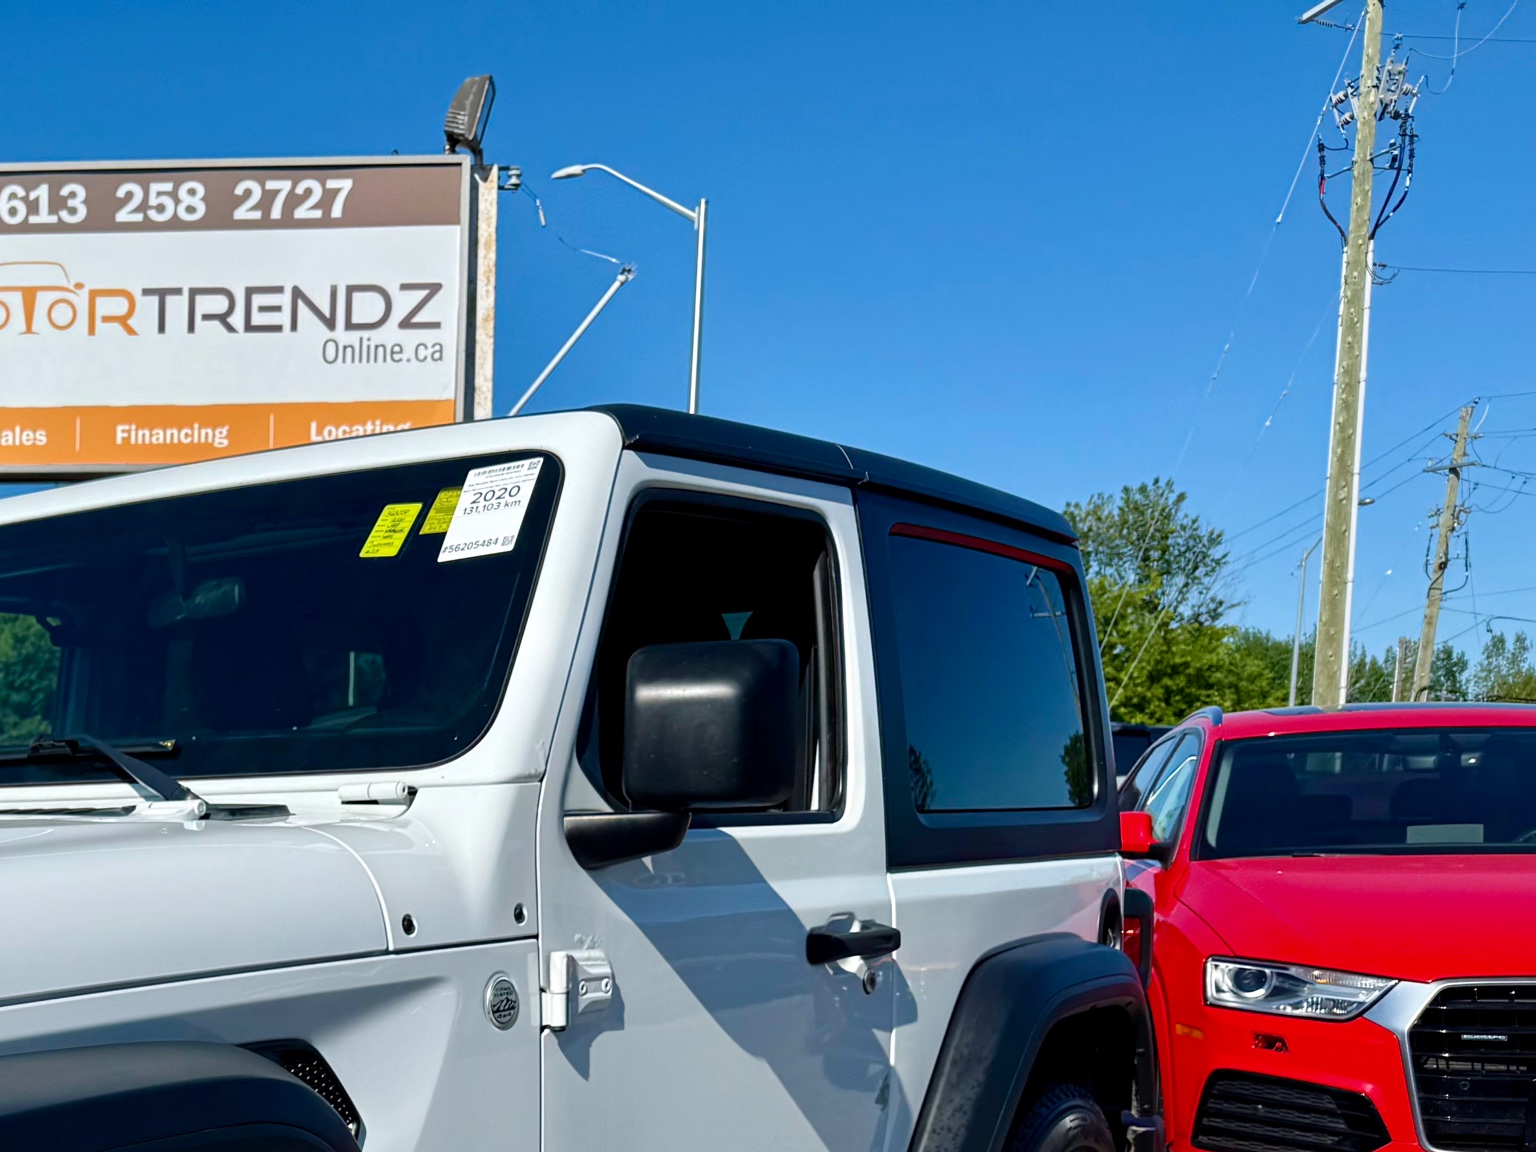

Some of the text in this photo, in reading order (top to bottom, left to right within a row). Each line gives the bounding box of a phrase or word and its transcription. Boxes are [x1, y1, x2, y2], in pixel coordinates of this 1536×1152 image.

[114, 181, 206, 222] 258
[232, 178, 354, 220] 2727
[322, 336, 444, 364] Online.ca
[115, 423, 230, 449] Financing
[470, 485, 521, 505] 2020
[463, 499, 522, 516] 131,103 km
[442, 537, 499, 554] #56205484
